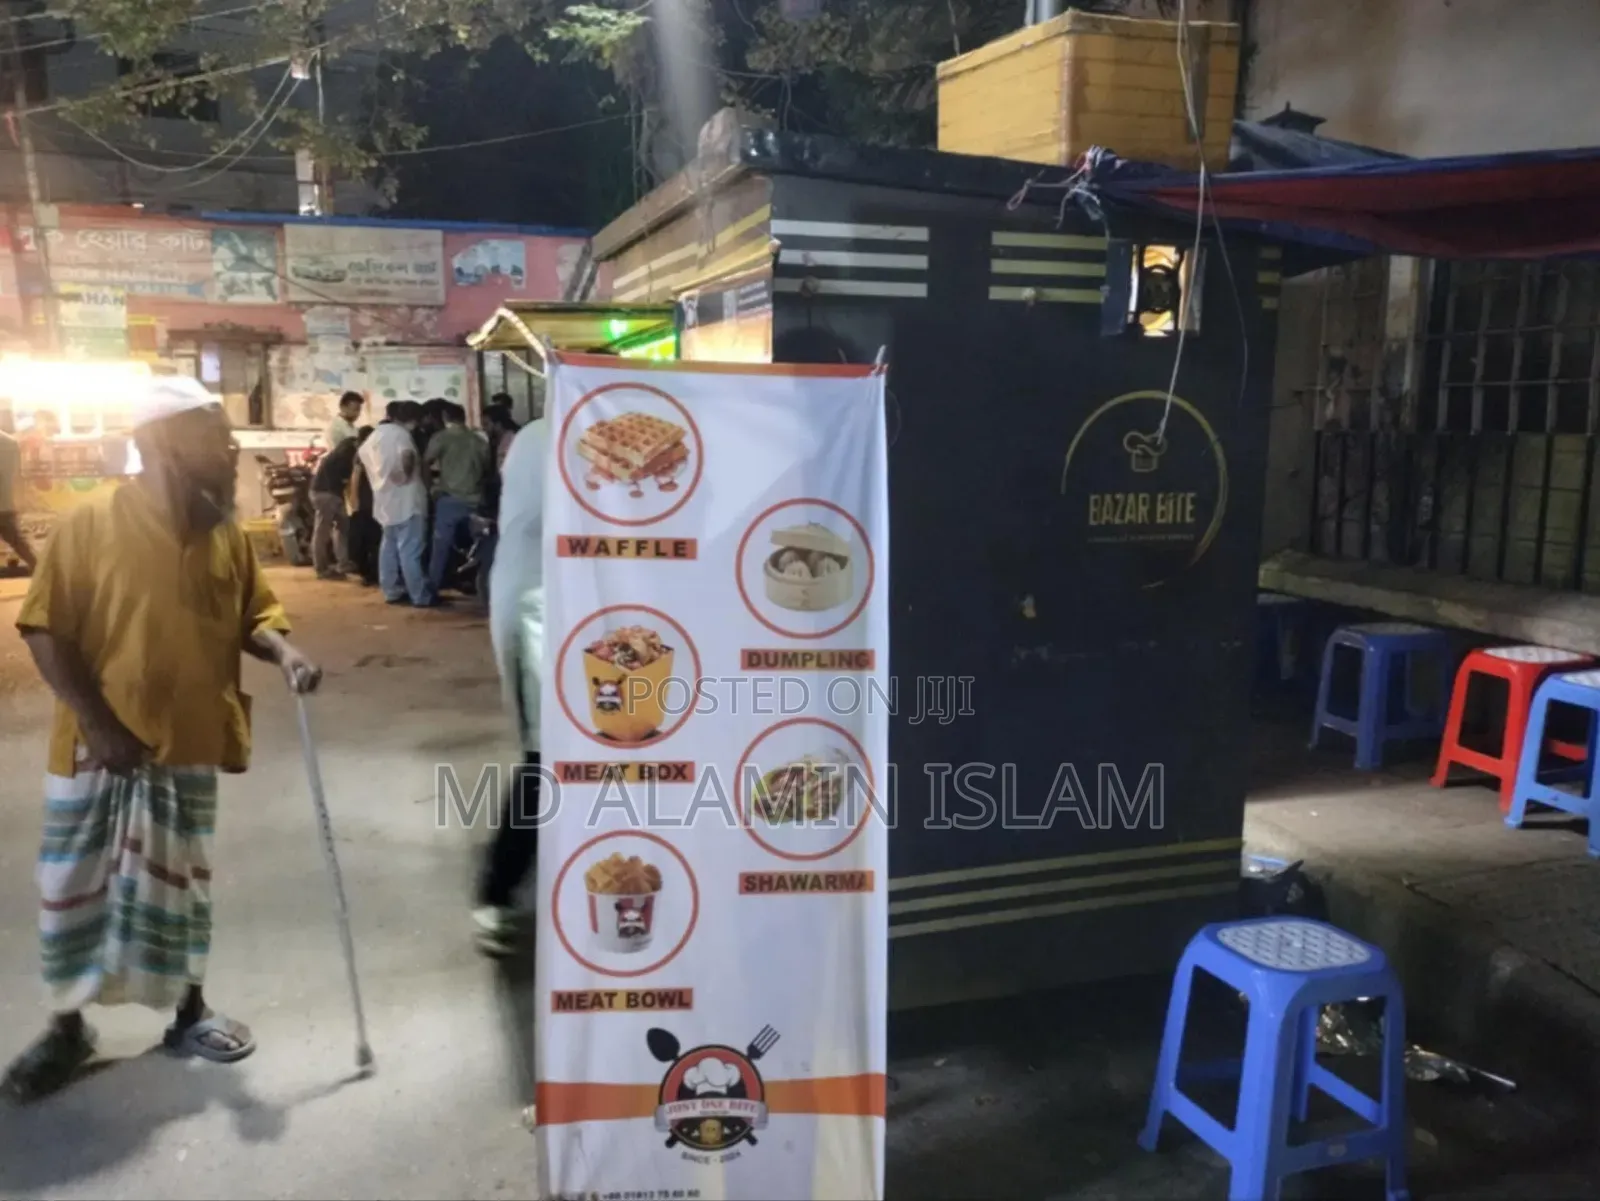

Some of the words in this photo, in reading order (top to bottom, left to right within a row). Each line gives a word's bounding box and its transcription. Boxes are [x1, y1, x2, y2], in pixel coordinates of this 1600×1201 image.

[1088, 493, 1151, 526] BAZAR
[567, 537, 688, 557] WAFFLE
[746, 650, 871, 668] DUMPLING
[563, 764, 630, 781] MEAT
[638, 764, 688, 781] BOX
[555, 992, 618, 1011] MEAT
[625, 990, 691, 1009] BOWL
